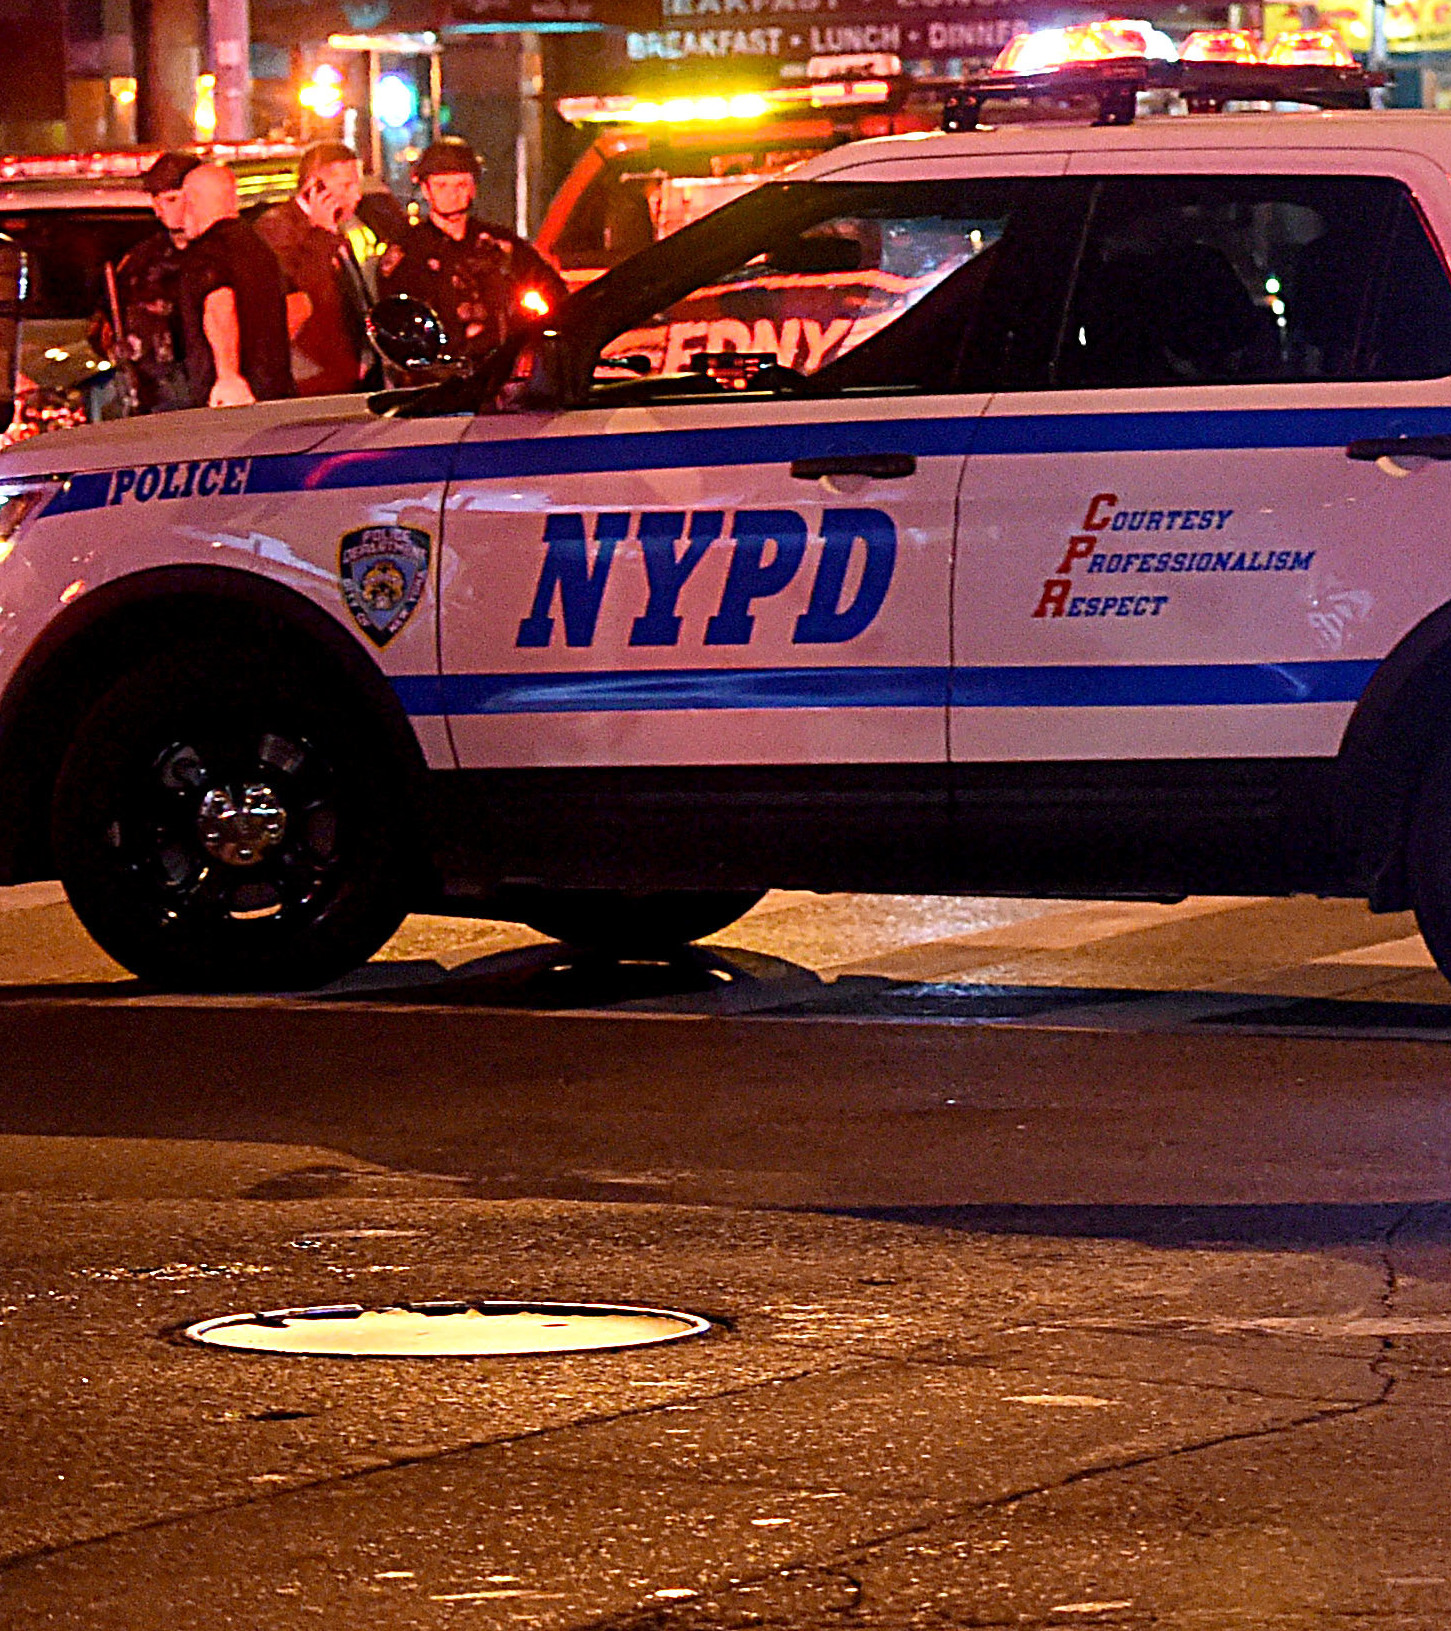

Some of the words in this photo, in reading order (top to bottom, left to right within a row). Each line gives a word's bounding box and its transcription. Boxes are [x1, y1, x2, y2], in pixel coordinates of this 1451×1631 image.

[626, 25, 783, 61] BREAKFAST
[809, 22, 900, 54] LUNCH
[663, 318, 857, 375] FDNY
[109, 458, 249, 506] POLICE
[1082, 492, 1234, 532] COURTESY
[1055, 535, 1316, 575] PROFESSIONALISM
[516, 506, 898, 650] NYPD
[1031, 578, 1169, 618] RESPECT
